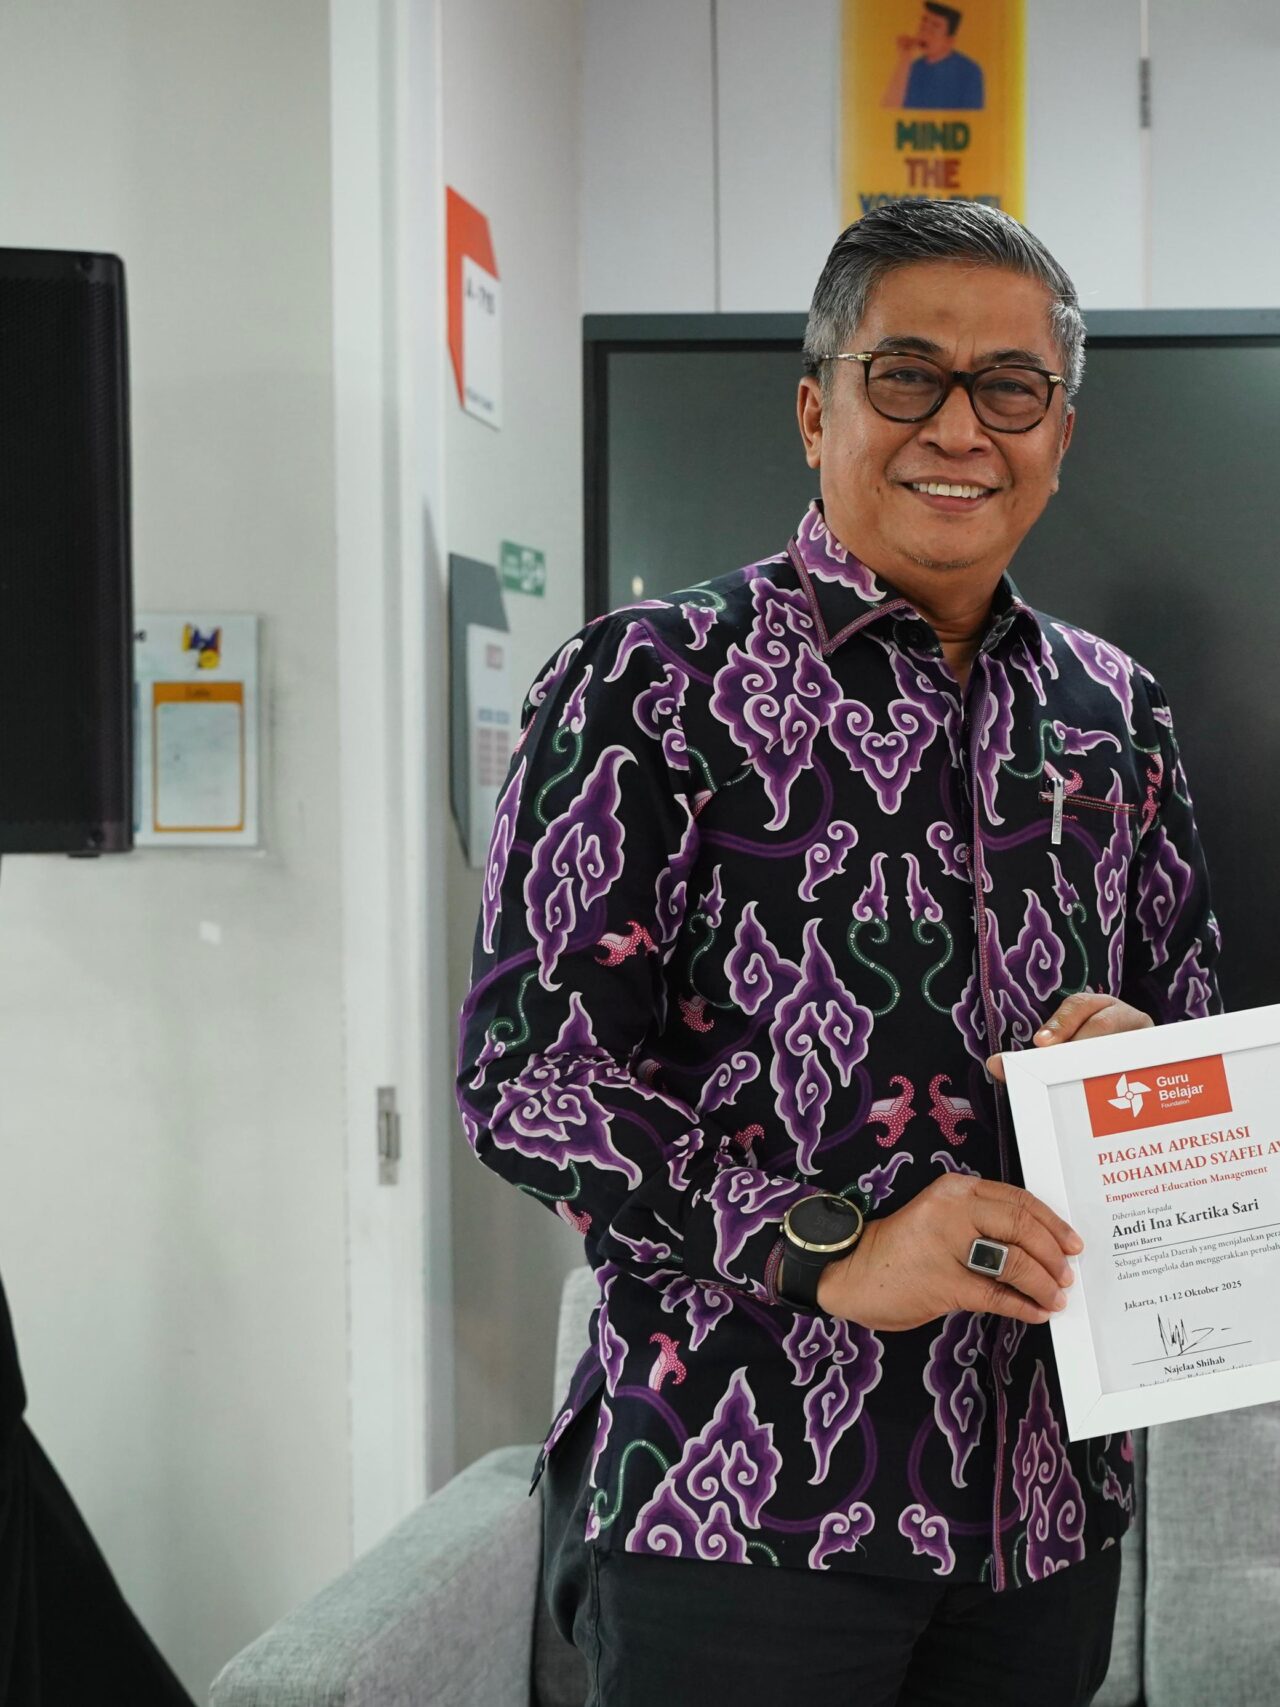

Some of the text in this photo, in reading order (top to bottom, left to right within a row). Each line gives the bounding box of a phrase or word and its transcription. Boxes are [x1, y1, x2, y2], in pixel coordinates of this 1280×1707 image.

[895, 121, 970, 151] MIND
[905, 158, 960, 188] THE
[1156, 1074, 1189, 1087] Guru
[1159, 1085, 1204, 1101] Belajar
[1161, 1099, 1190, 1108] Foundation
[1098, 1126, 1251, 1165] PIAGAM APRESIASI
[1102, 1155, 1207, 1185] MOHAMMAD
[1210, 1144, 1263, 1166] SYAFEI
[1105, 1166, 1268, 1203] Empowered Education Management
[1112, 1203, 1172, 1221] Diberikan kepada
[1112, 1198, 1260, 1238] Andi Ina Kartika Sari
[1113, 1236, 1163, 1251] Bupati Barru
[1114, 1256, 1143, 1268] Sebagai
[1144, 1251, 1170, 1263] Kepala
[1171, 1245, 1198, 1257] Daerah
[1199, 1242, 1217, 1253] yang
[1218, 1233, 1265, 1249] menjalankan
[1117, 1270, 1140, 1281] dalam
[1141, 1263, 1179, 1276] mengelola
[1179, 1260, 1194, 1268] dan
[1195, 1250, 1249, 1265] menggerakkan
[1124, 1280, 1242, 1312] Jakarta, 11-12 Oktober 2025
[1163, 1364, 1195, 1375] Najelaa
[1196, 1356, 1226, 1368] Shihab
